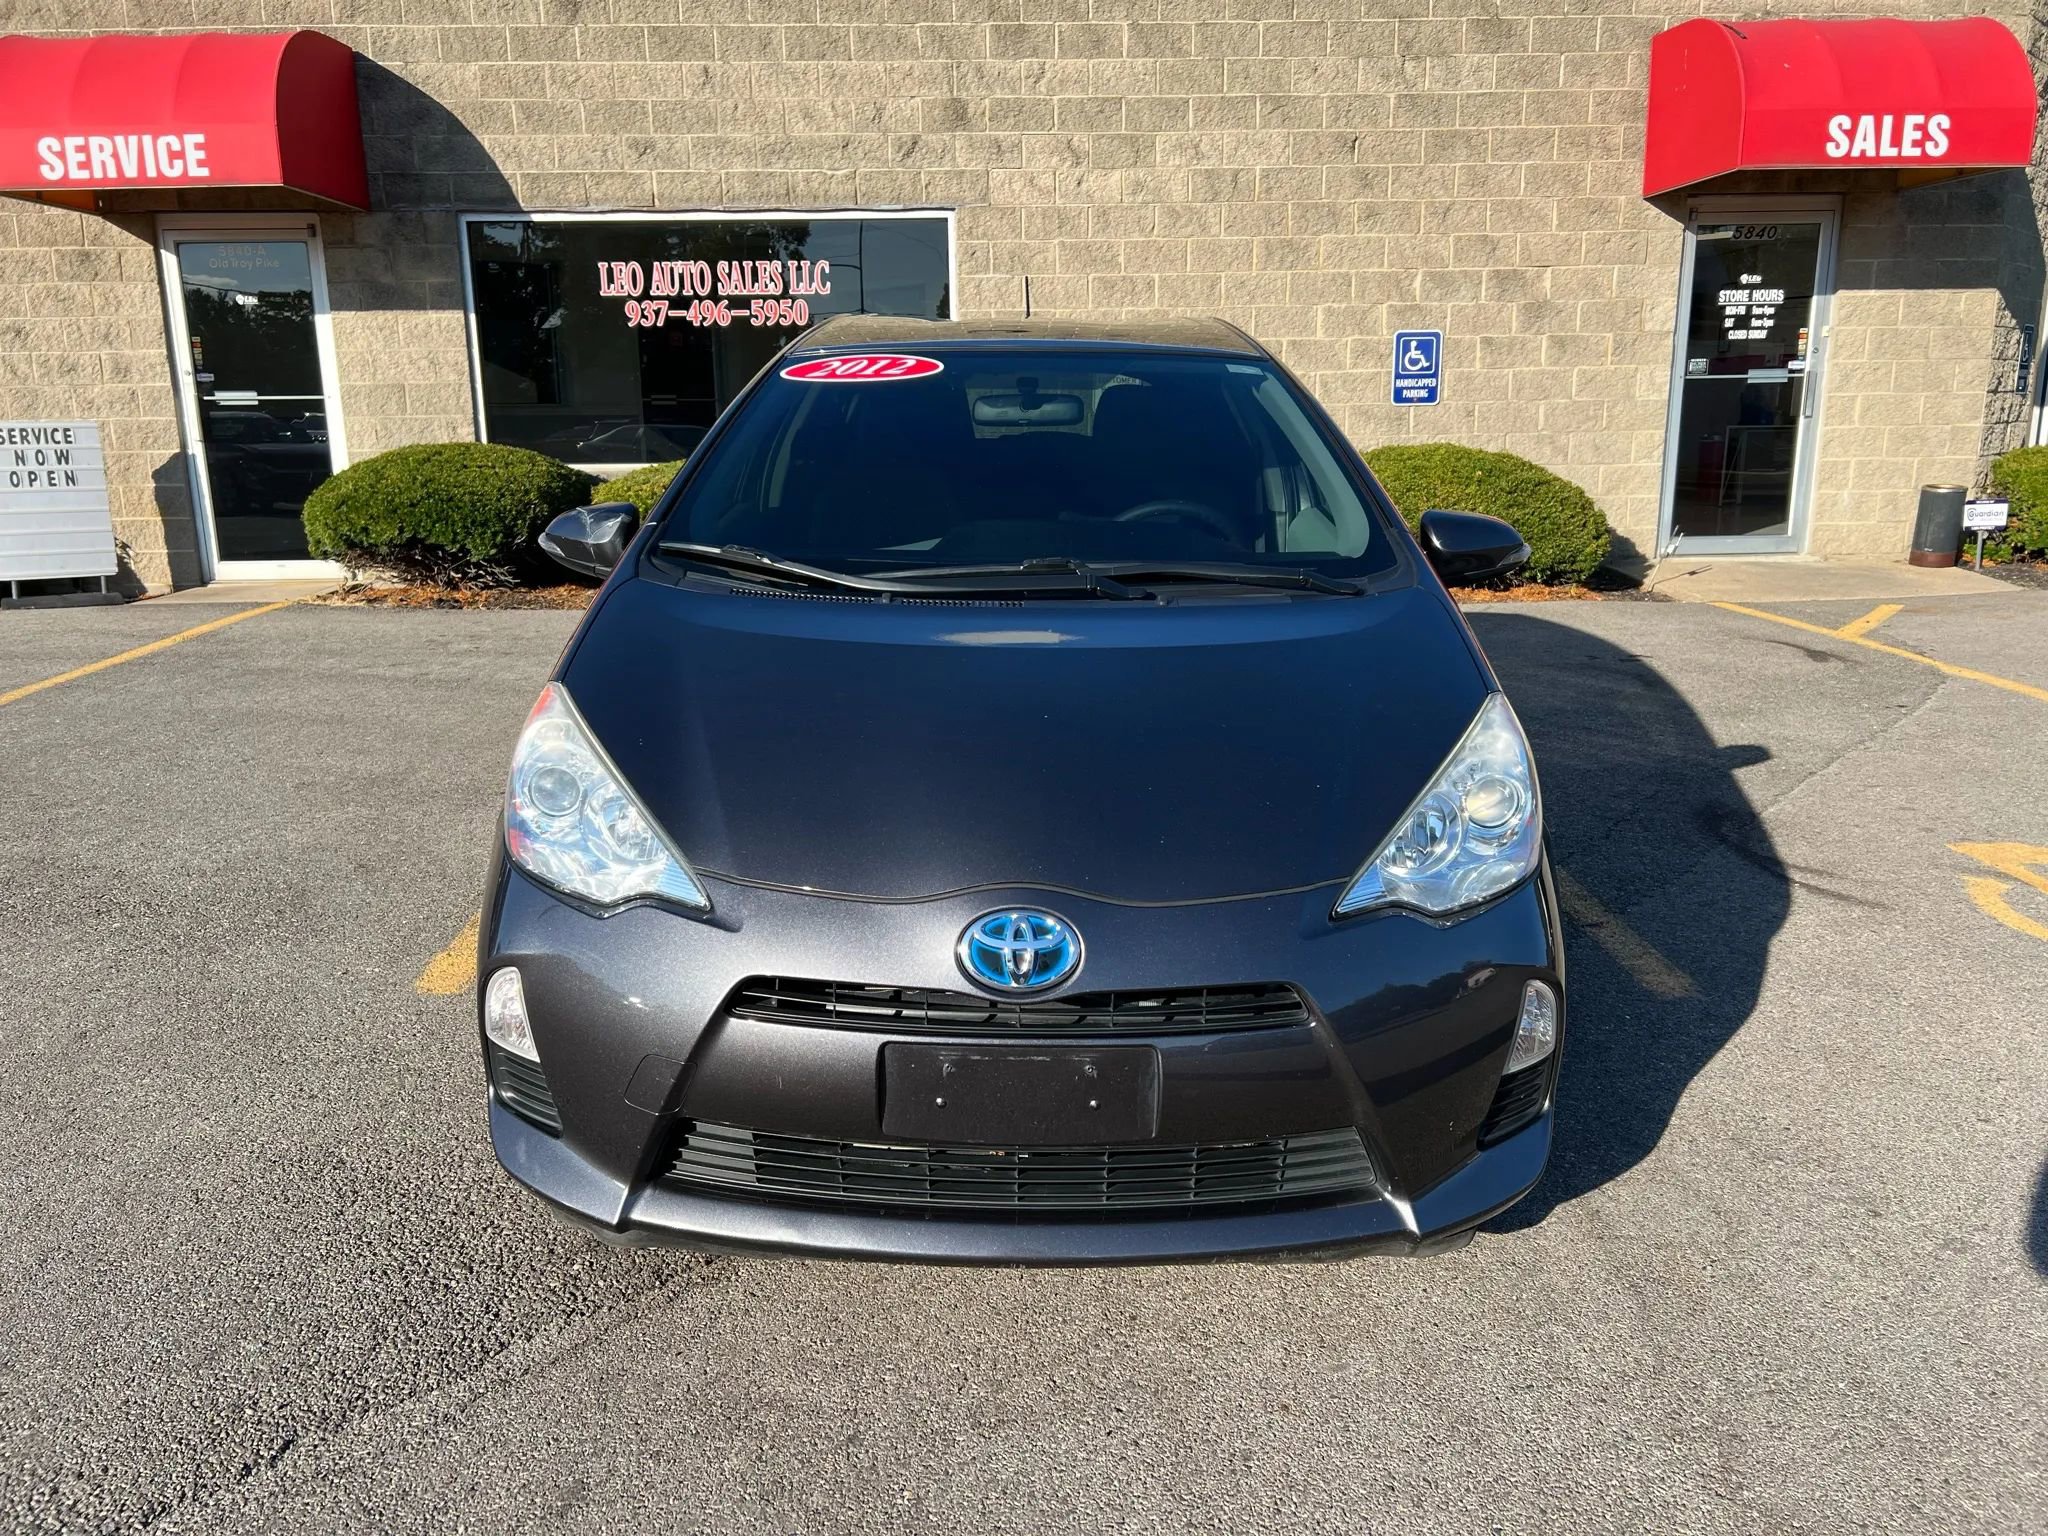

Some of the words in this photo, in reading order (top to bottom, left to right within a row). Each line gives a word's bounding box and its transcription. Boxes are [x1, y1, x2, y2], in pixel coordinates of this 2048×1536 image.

[1825, 114, 1950, 158] SALES
[37, 134, 210, 180] SERVICE
[1733, 225, 1777, 239] 5840
[208, 258, 229, 268] Old
[231, 258, 253, 270] Troy
[256, 258, 280, 268] Pike
[598, 261, 644, 297] LEO
[650, 260, 712, 296] AUTO
[716, 260, 784, 296] SALES
[789, 260, 831, 295] LLC
[1719, 289, 1750, 302] STORE
[1752, 289, 1784, 302] HOURS
[624, 299, 809, 328] 937-496-5950
[1724, 318, 1735, 328] SAT
[1728, 329, 1748, 339] CLOSED
[1748, 329, 1768, 339] SUNDAY
[805, 359, 909, 377] 2012
[1396, 378, 1437, 388] HANDICAPPED
[1403, 389, 1429, 398] PARKING
[0, 427, 74, 446] SERVICE
[14, 448, 70, 467] NOW
[10, 469, 76, 488] OPEN
[1967, 508, 2004, 519] Guardian
